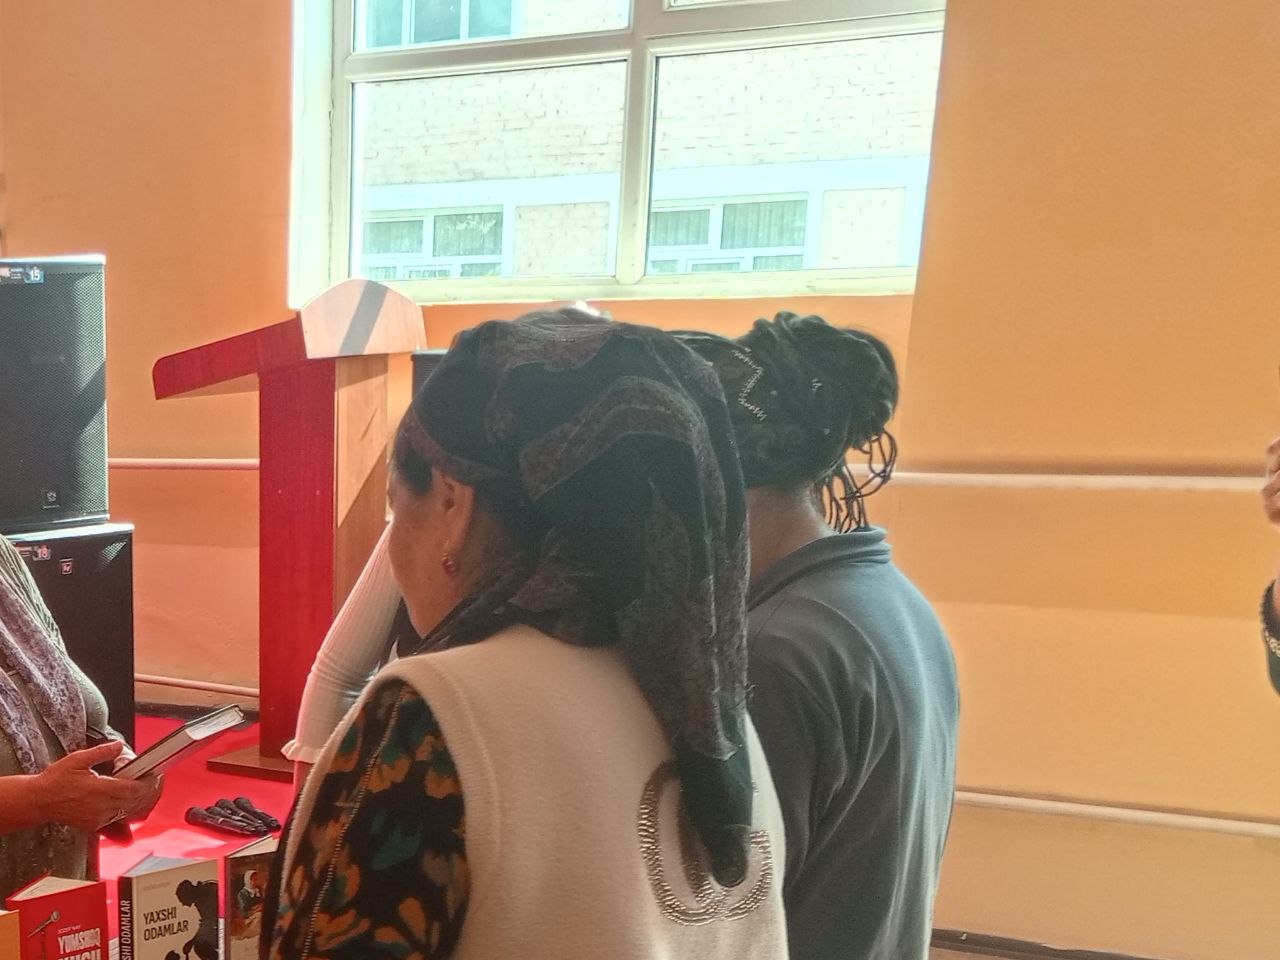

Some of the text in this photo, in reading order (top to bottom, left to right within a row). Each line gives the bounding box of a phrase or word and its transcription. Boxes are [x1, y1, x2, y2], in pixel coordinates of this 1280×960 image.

[29, 270, 40, 281] 15
[37, 547, 48, 558] 18
[121, 899, 131, 946] ODAMLAR
[143, 907, 177, 926] YAXSHI
[143, 920, 189, 942] ODAMLAR
[58, 928, 101, 955] YUMSHOQ
